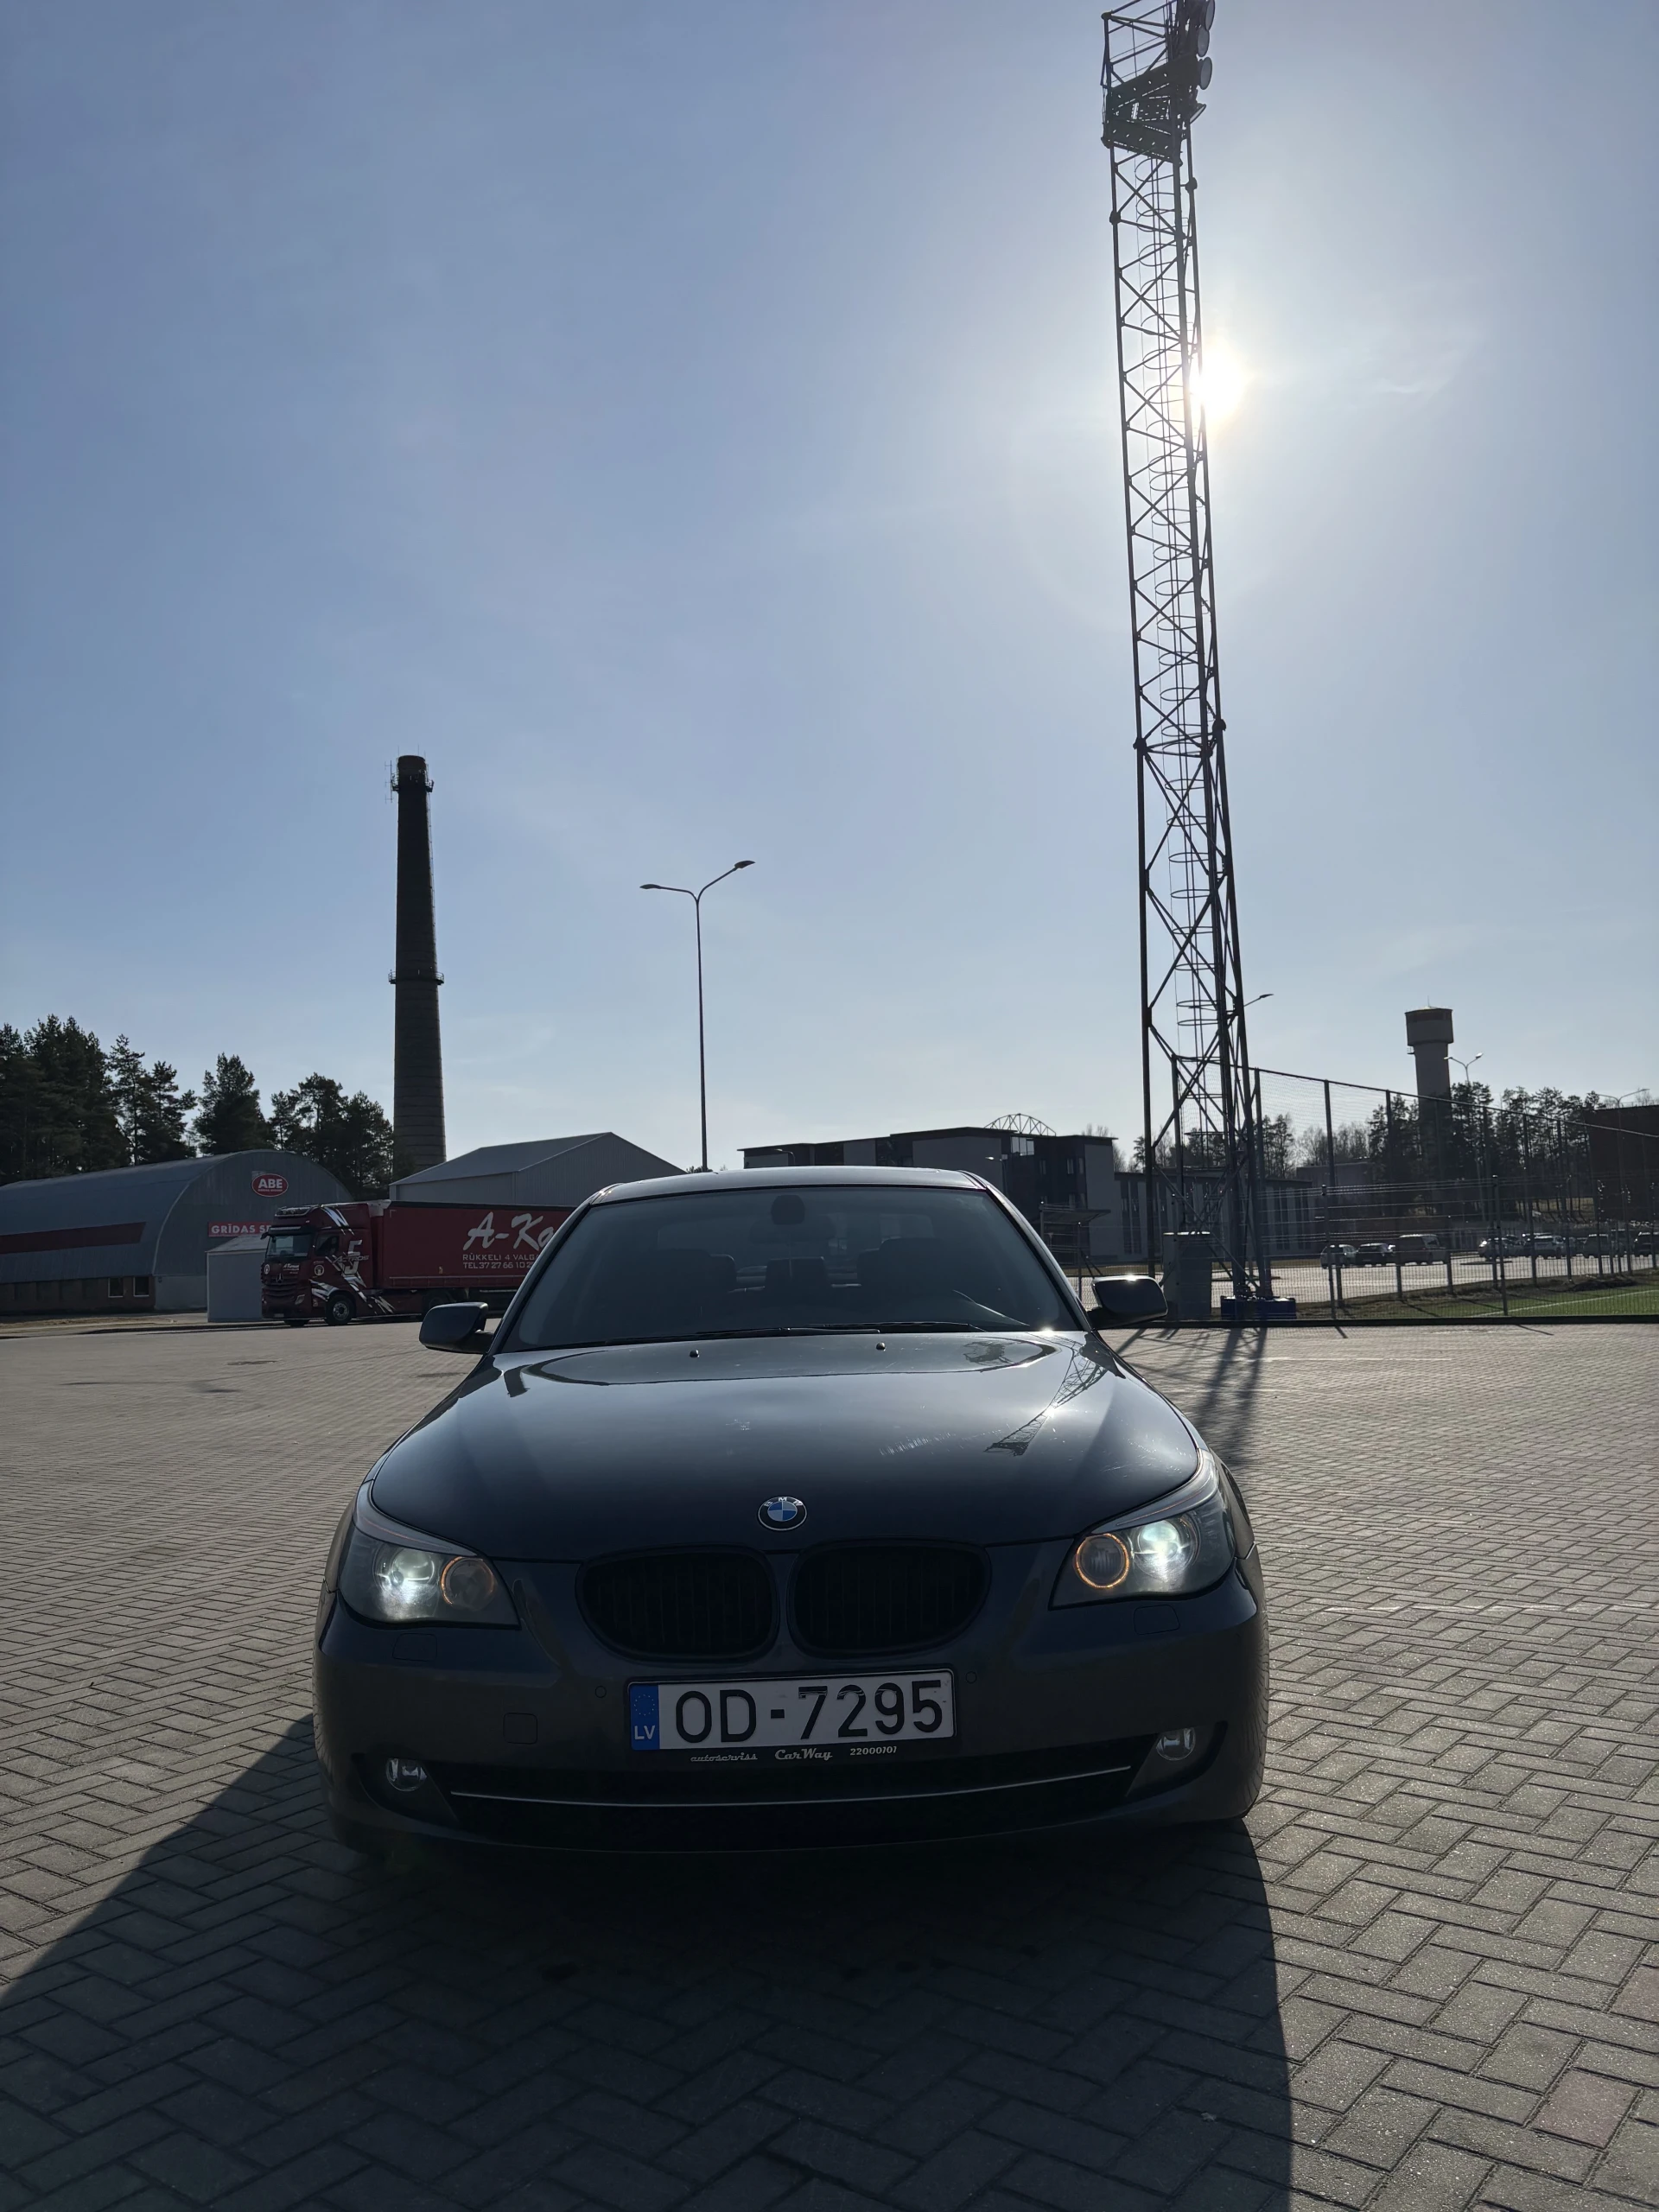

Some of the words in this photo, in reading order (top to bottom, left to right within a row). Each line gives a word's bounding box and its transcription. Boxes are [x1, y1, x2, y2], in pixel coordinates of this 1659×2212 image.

[258, 1179, 283, 1188] ABE
[211, 1224, 255, 1234] GRĪDAS
[763, 1497, 804, 1507] BMW
[676, 1680, 942, 1743] OD-7295
[634, 1726, 655, 1740] LV
[690, 1751, 758, 1762] autoserviss
